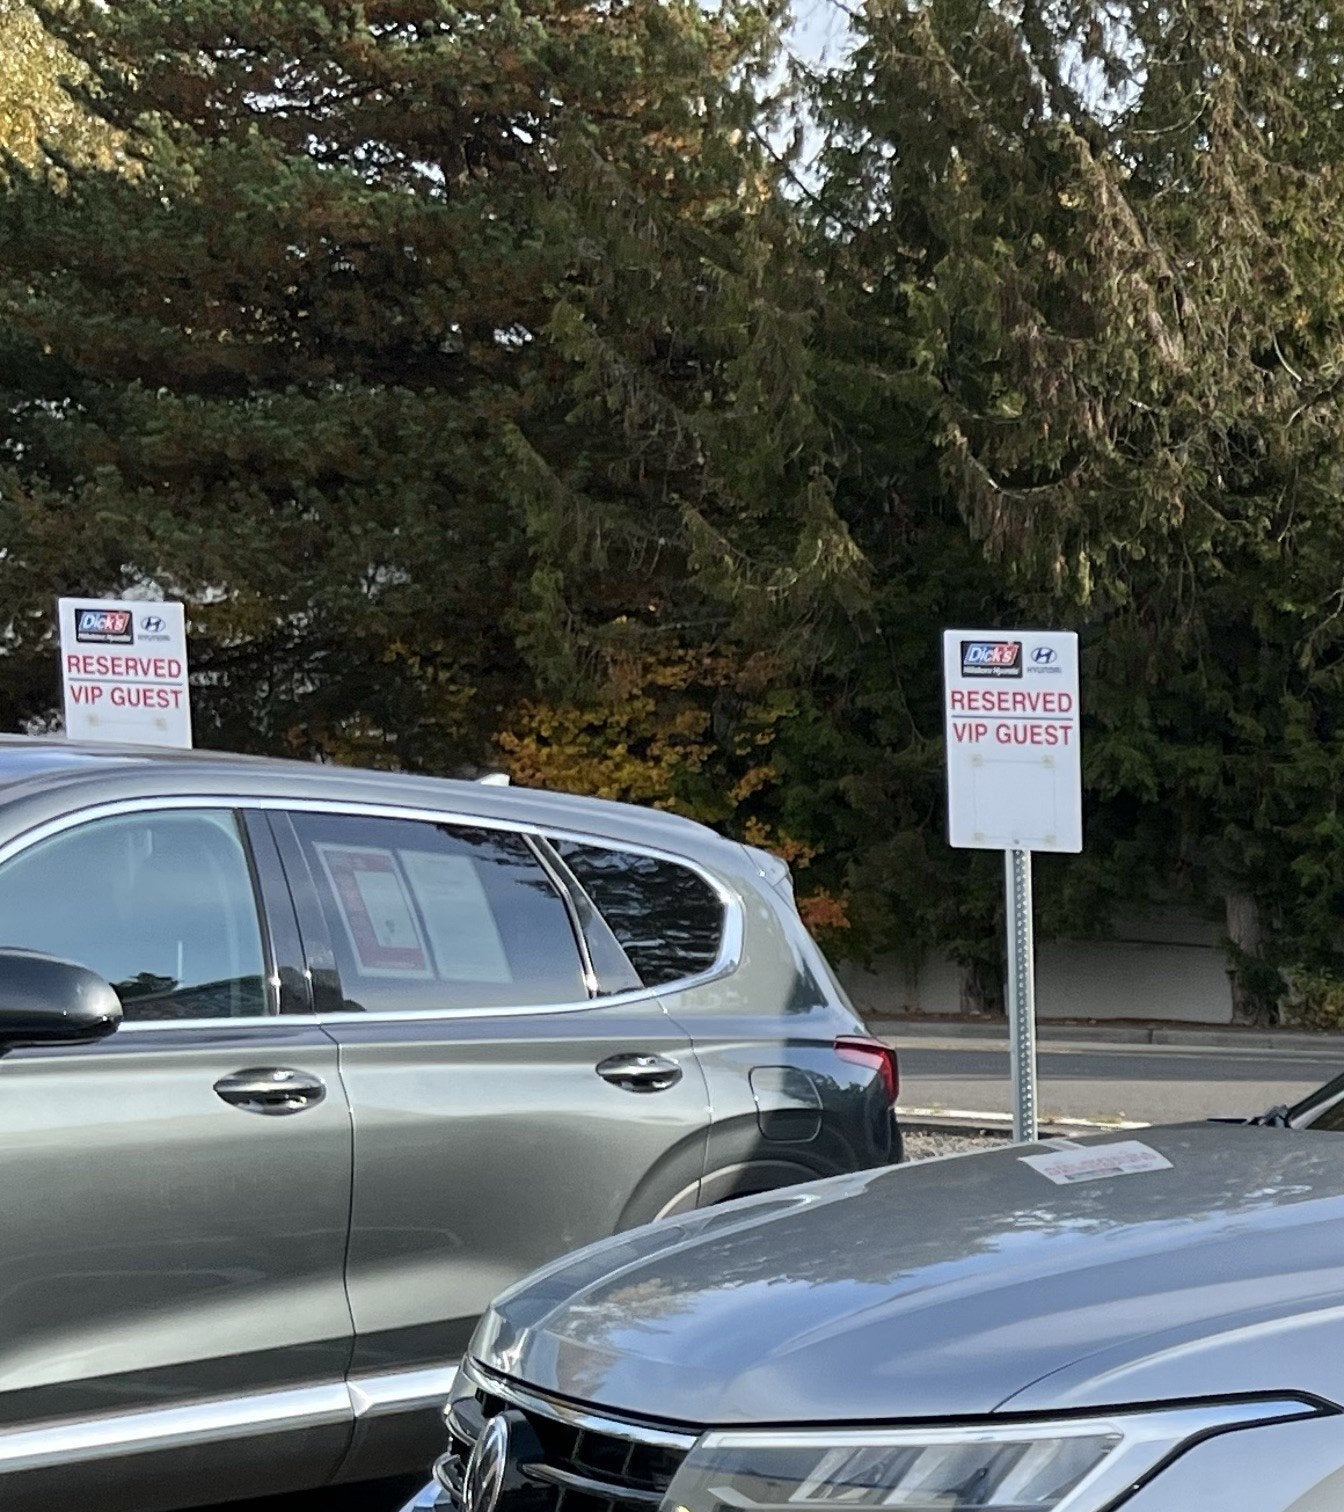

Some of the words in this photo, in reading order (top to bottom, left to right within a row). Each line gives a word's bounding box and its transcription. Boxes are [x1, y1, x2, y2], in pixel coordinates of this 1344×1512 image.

[66, 654, 181, 679] RESERVED
[69, 684, 103, 705] VIP
[110, 686, 183, 709] GUEST
[951, 690, 1073, 713] RESERVED
[952, 722, 988, 743] VIP
[995, 724, 1073, 746] GUEST
